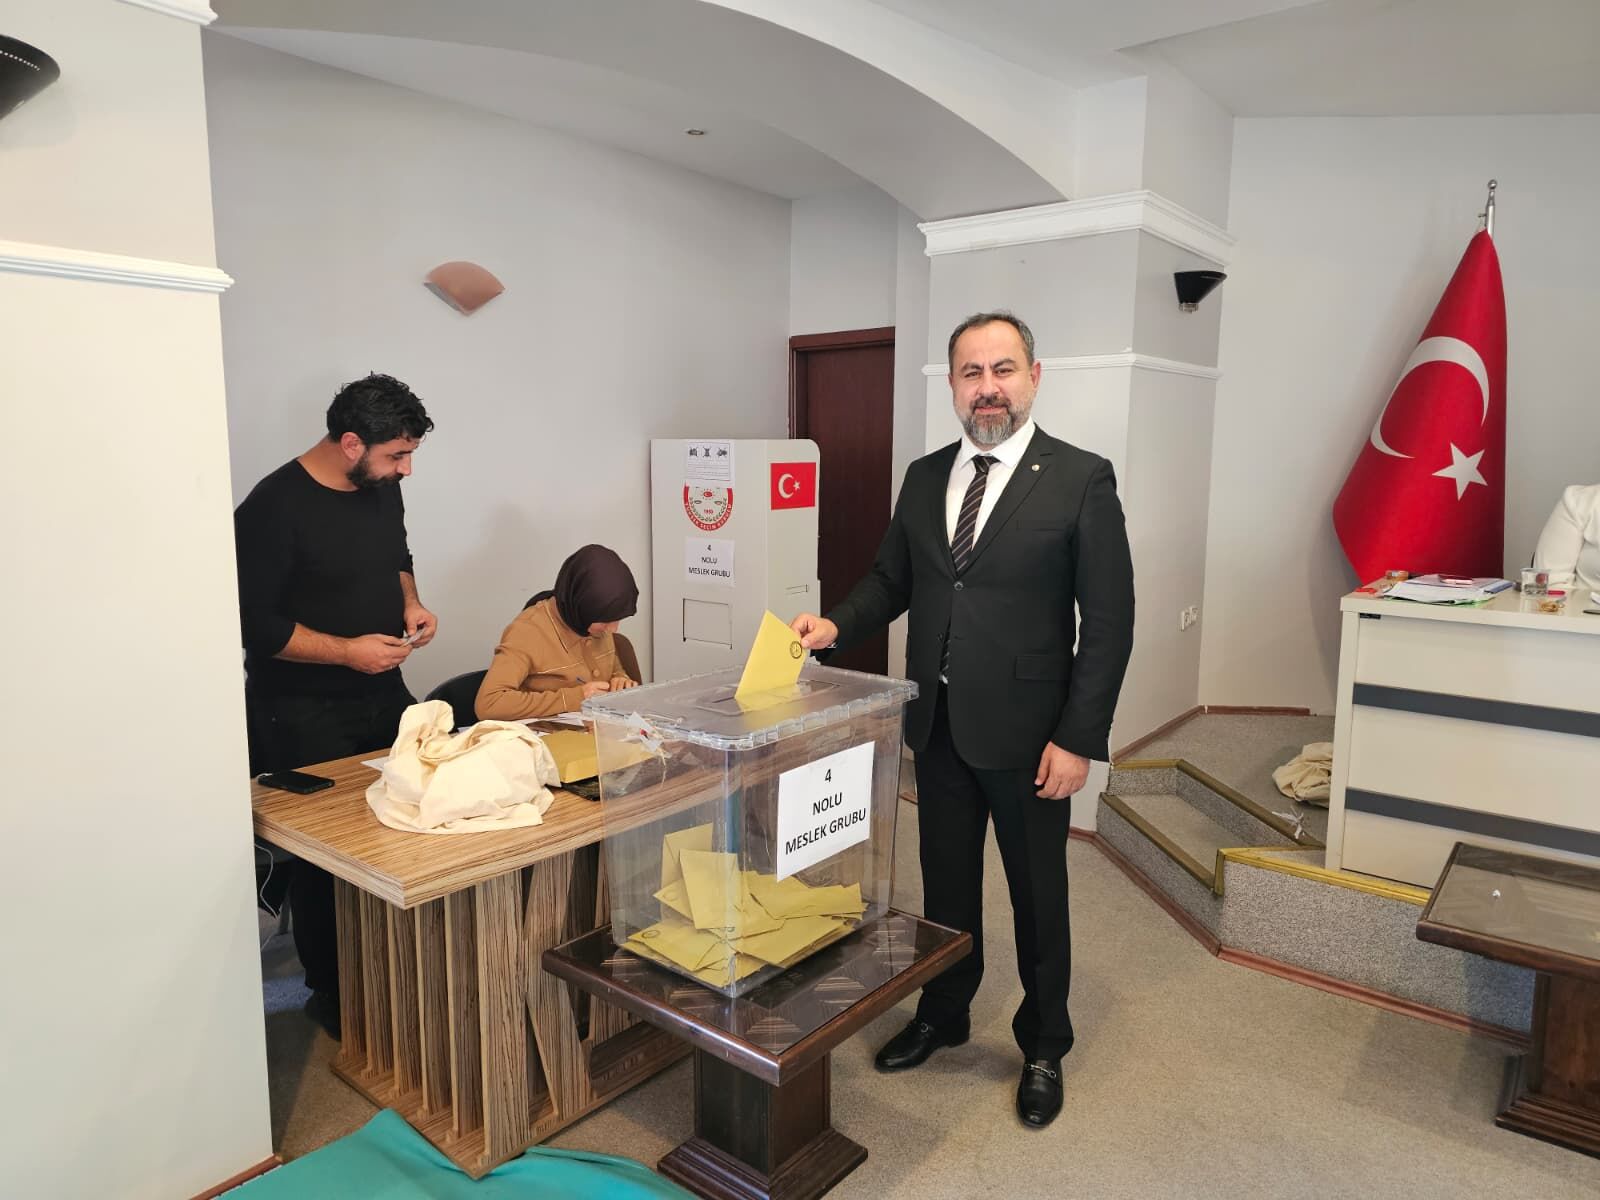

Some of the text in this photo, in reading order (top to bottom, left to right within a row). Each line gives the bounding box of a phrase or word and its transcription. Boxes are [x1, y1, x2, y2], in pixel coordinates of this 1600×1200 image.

[701, 556, 718, 564] NOLU
[688, 567, 731, 577] MESLEK GRUBU
[824, 768, 832, 783] 4
[812, 792, 842, 816] NOLU
[785, 808, 866, 855] MESLEK GRUBU
